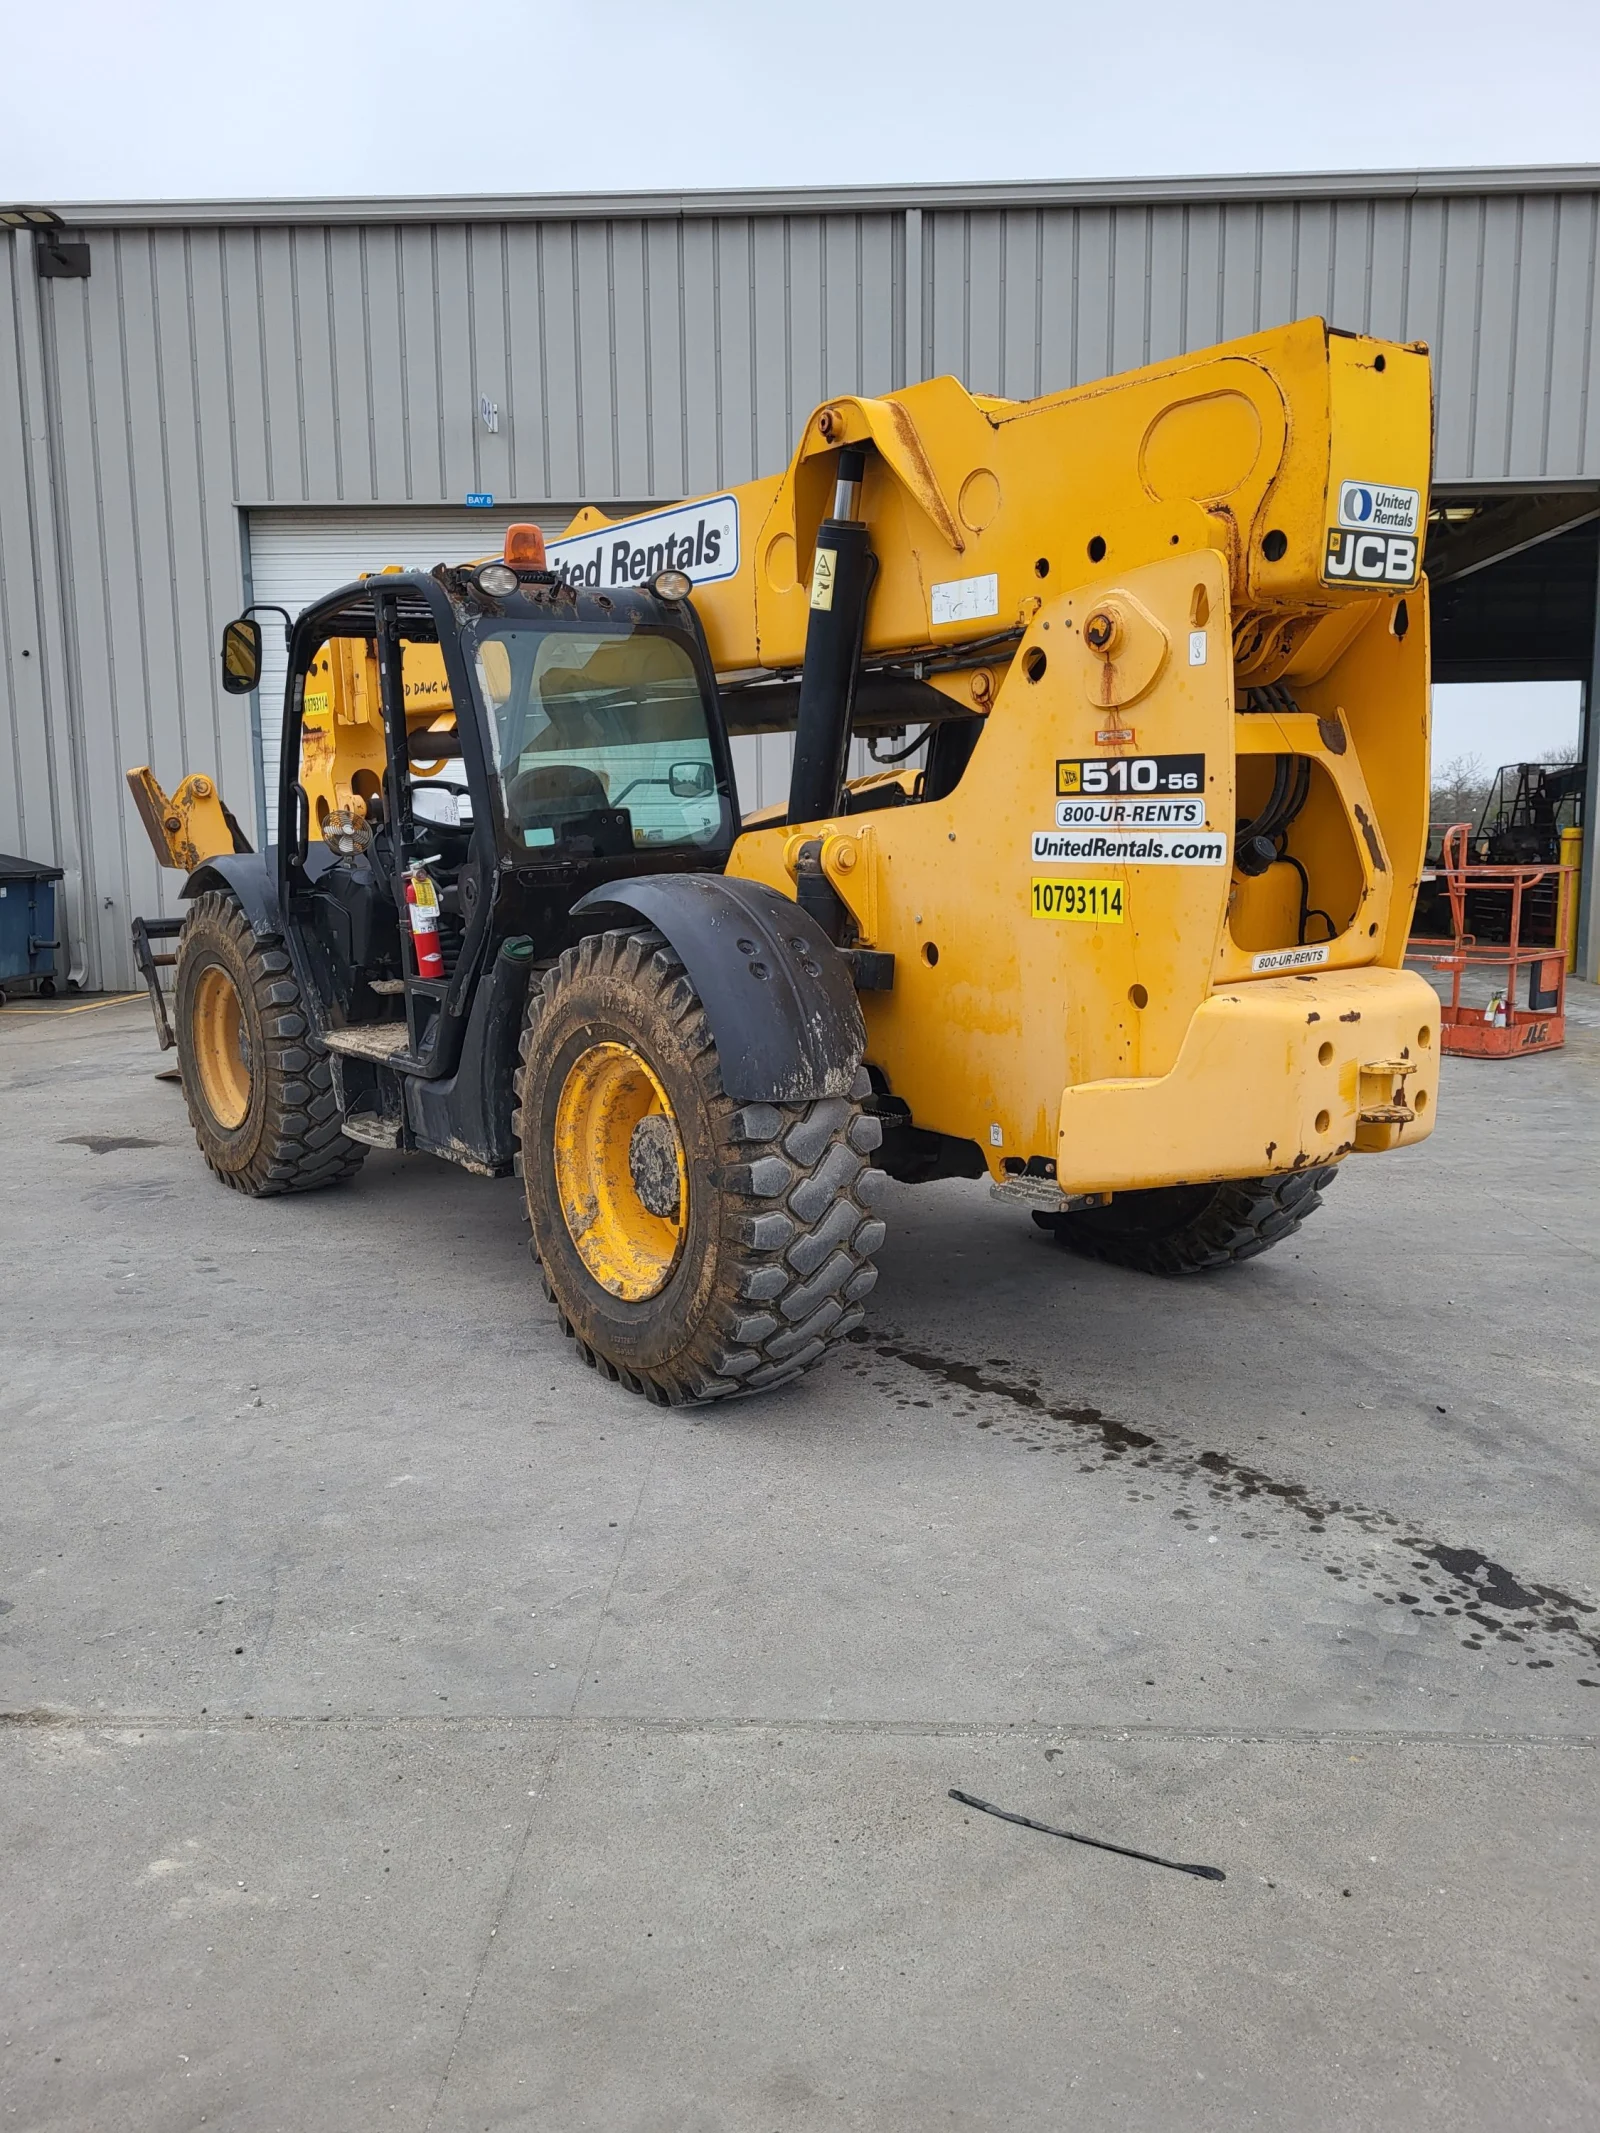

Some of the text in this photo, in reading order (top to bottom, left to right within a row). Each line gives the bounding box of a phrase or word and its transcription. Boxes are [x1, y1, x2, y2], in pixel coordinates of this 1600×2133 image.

[468, 496, 485, 504] BAY
[1375, 492, 1412, 510] United
[1373, 509, 1413, 527] Rentals
[1327, 534, 1416, 580] JCB
[554, 546, 603, 588] ted
[414, 681, 438, 696] DAWG
[1082, 759, 1199, 793] 510-56
[1063, 804, 1196, 822] 800-UR-RENTS
[1034, 837, 1222, 859] UnitedRentals.com
[1033, 884, 1122, 916] 10793114
[1258, 950, 1324, 969] 800-UR-RENTS
